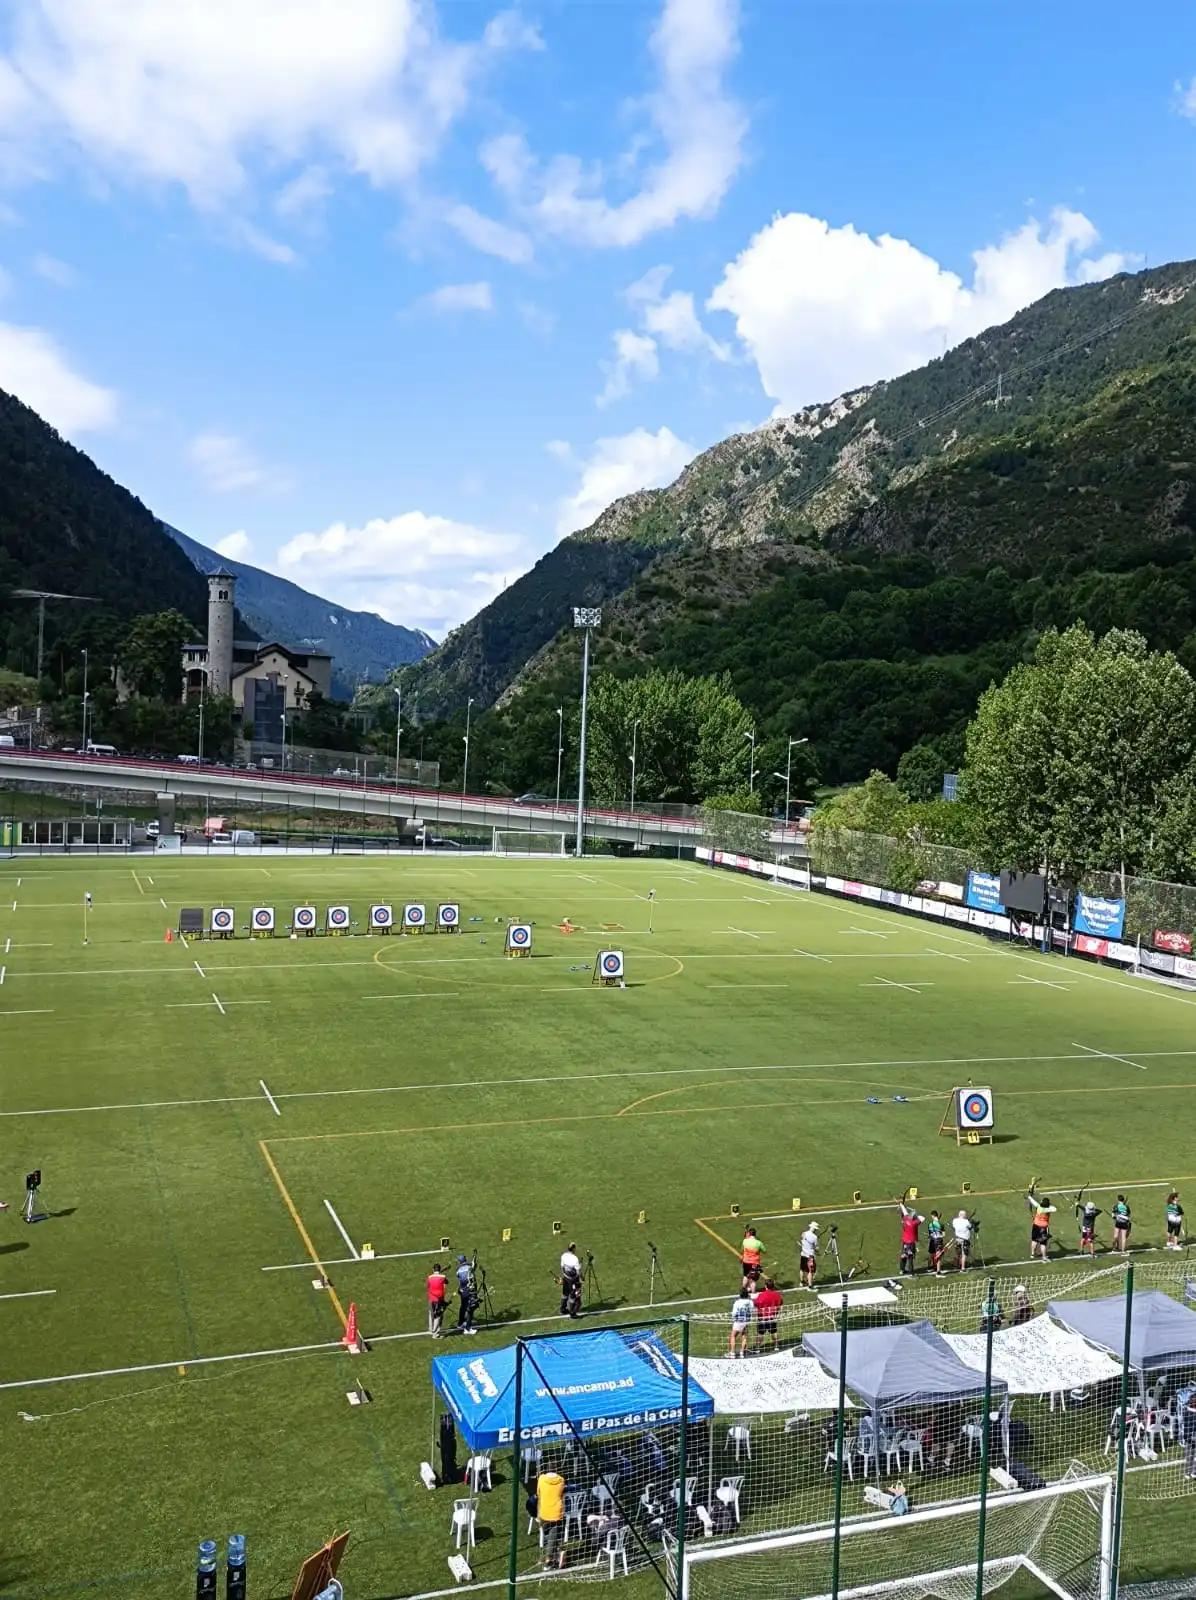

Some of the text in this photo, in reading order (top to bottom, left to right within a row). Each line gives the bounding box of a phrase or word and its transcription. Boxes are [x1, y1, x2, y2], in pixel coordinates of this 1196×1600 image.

[581, 1418, 594, 1432] El
[597, 1417, 621, 1429] Pas
[624, 1414, 641, 1425] de
[644, 1410, 657, 1422] la
